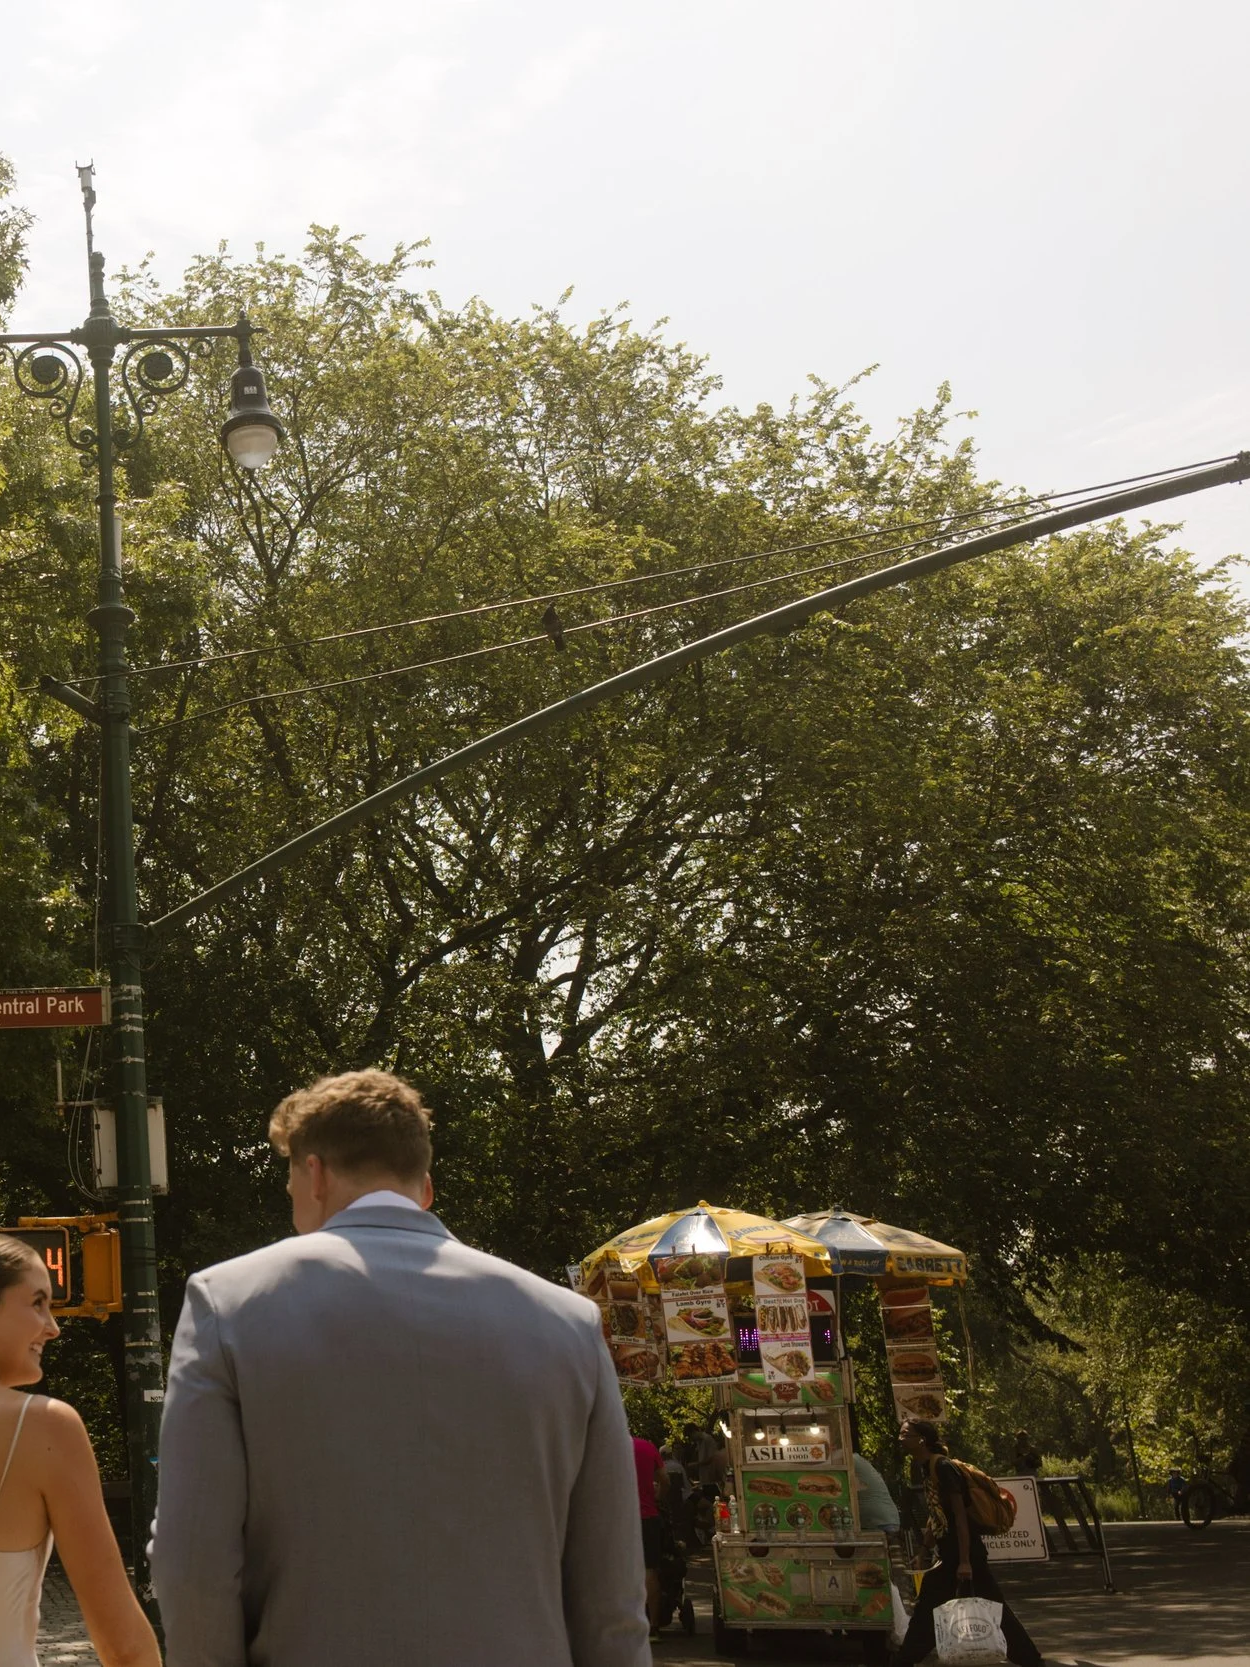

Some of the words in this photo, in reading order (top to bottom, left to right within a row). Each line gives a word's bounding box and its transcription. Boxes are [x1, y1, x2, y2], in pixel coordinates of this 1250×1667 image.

[47, 996, 84, 1013] Park
[46, 1247, 63, 1287] 4
[895, 1256, 963, 1272] SABRETT
[695, 1298, 711, 1306] Gyro
[749, 1447, 785, 1461] ASH
[1014, 1539, 1036, 1548] ONLY
[828, 1576, 839, 1589] A
